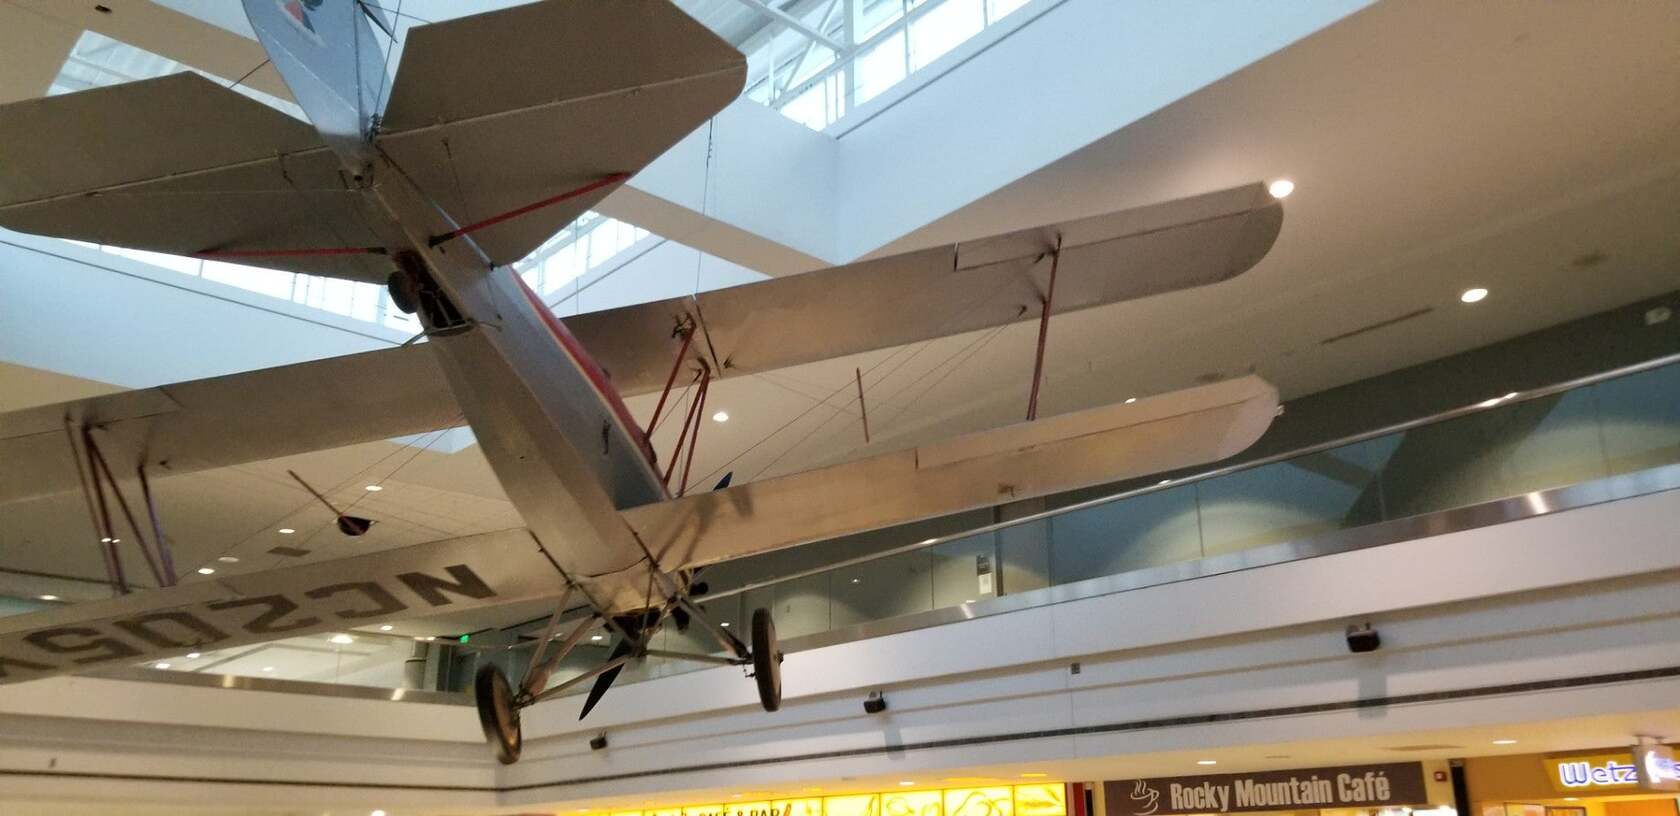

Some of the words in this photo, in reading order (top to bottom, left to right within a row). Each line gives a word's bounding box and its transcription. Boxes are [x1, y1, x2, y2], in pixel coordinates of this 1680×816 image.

[1559, 760, 1640, 787] Wetz
[1170, 781, 1229, 812] Rocky
[1234, 775, 1333, 807] Mountain
[1336, 771, 1391, 802] Café
